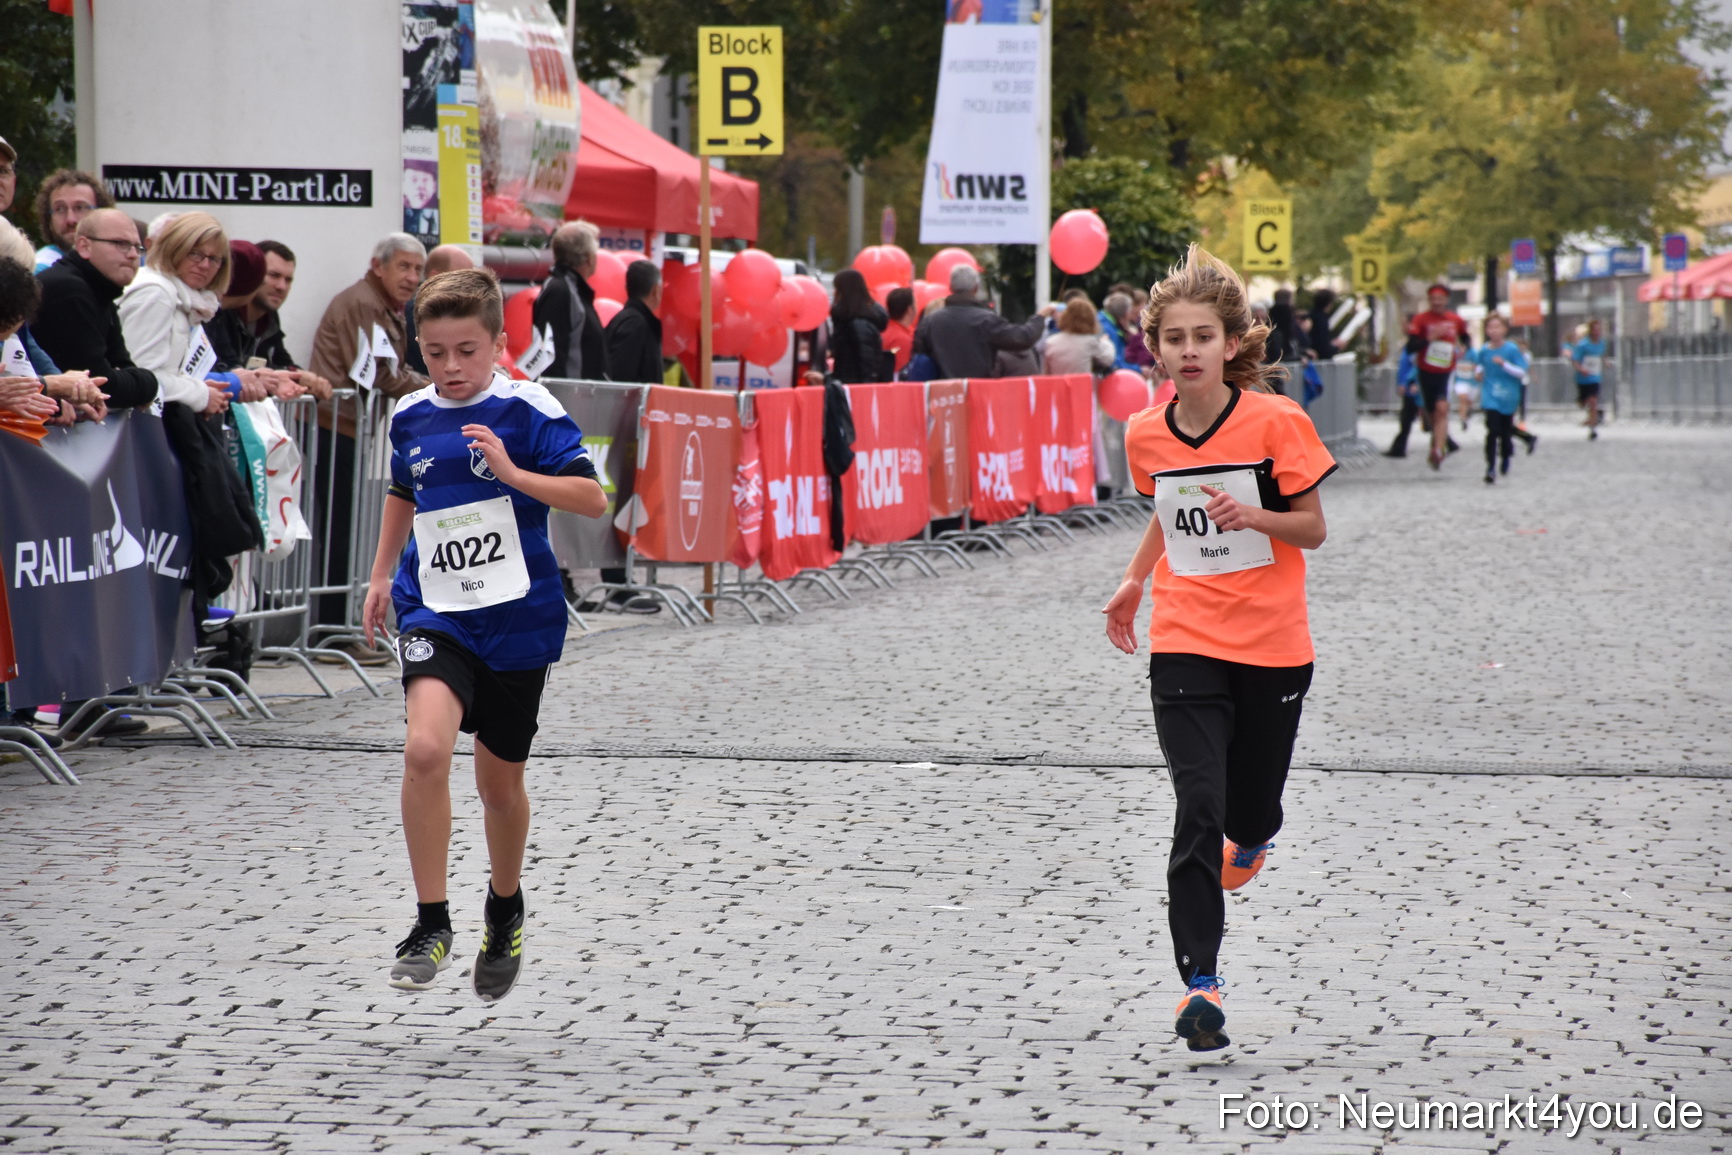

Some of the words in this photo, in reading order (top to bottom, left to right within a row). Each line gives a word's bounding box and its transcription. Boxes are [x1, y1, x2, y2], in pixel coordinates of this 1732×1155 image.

[709, 33, 772, 55] Block
[722, 67, 762, 126] B
[441, 124, 466, 149] 18.
[104, 171, 362, 203] www.MINI-Partl.de
[1256, 221, 1278, 254] C
[1361, 258, 1379, 283] D
[445, 512, 481, 528] BOCK
[1175, 507, 1241, 536] 40
[430, 532, 506, 573] 4022
[1200, 545, 1230, 558] Marie
[461, 580, 485, 592] Nico
